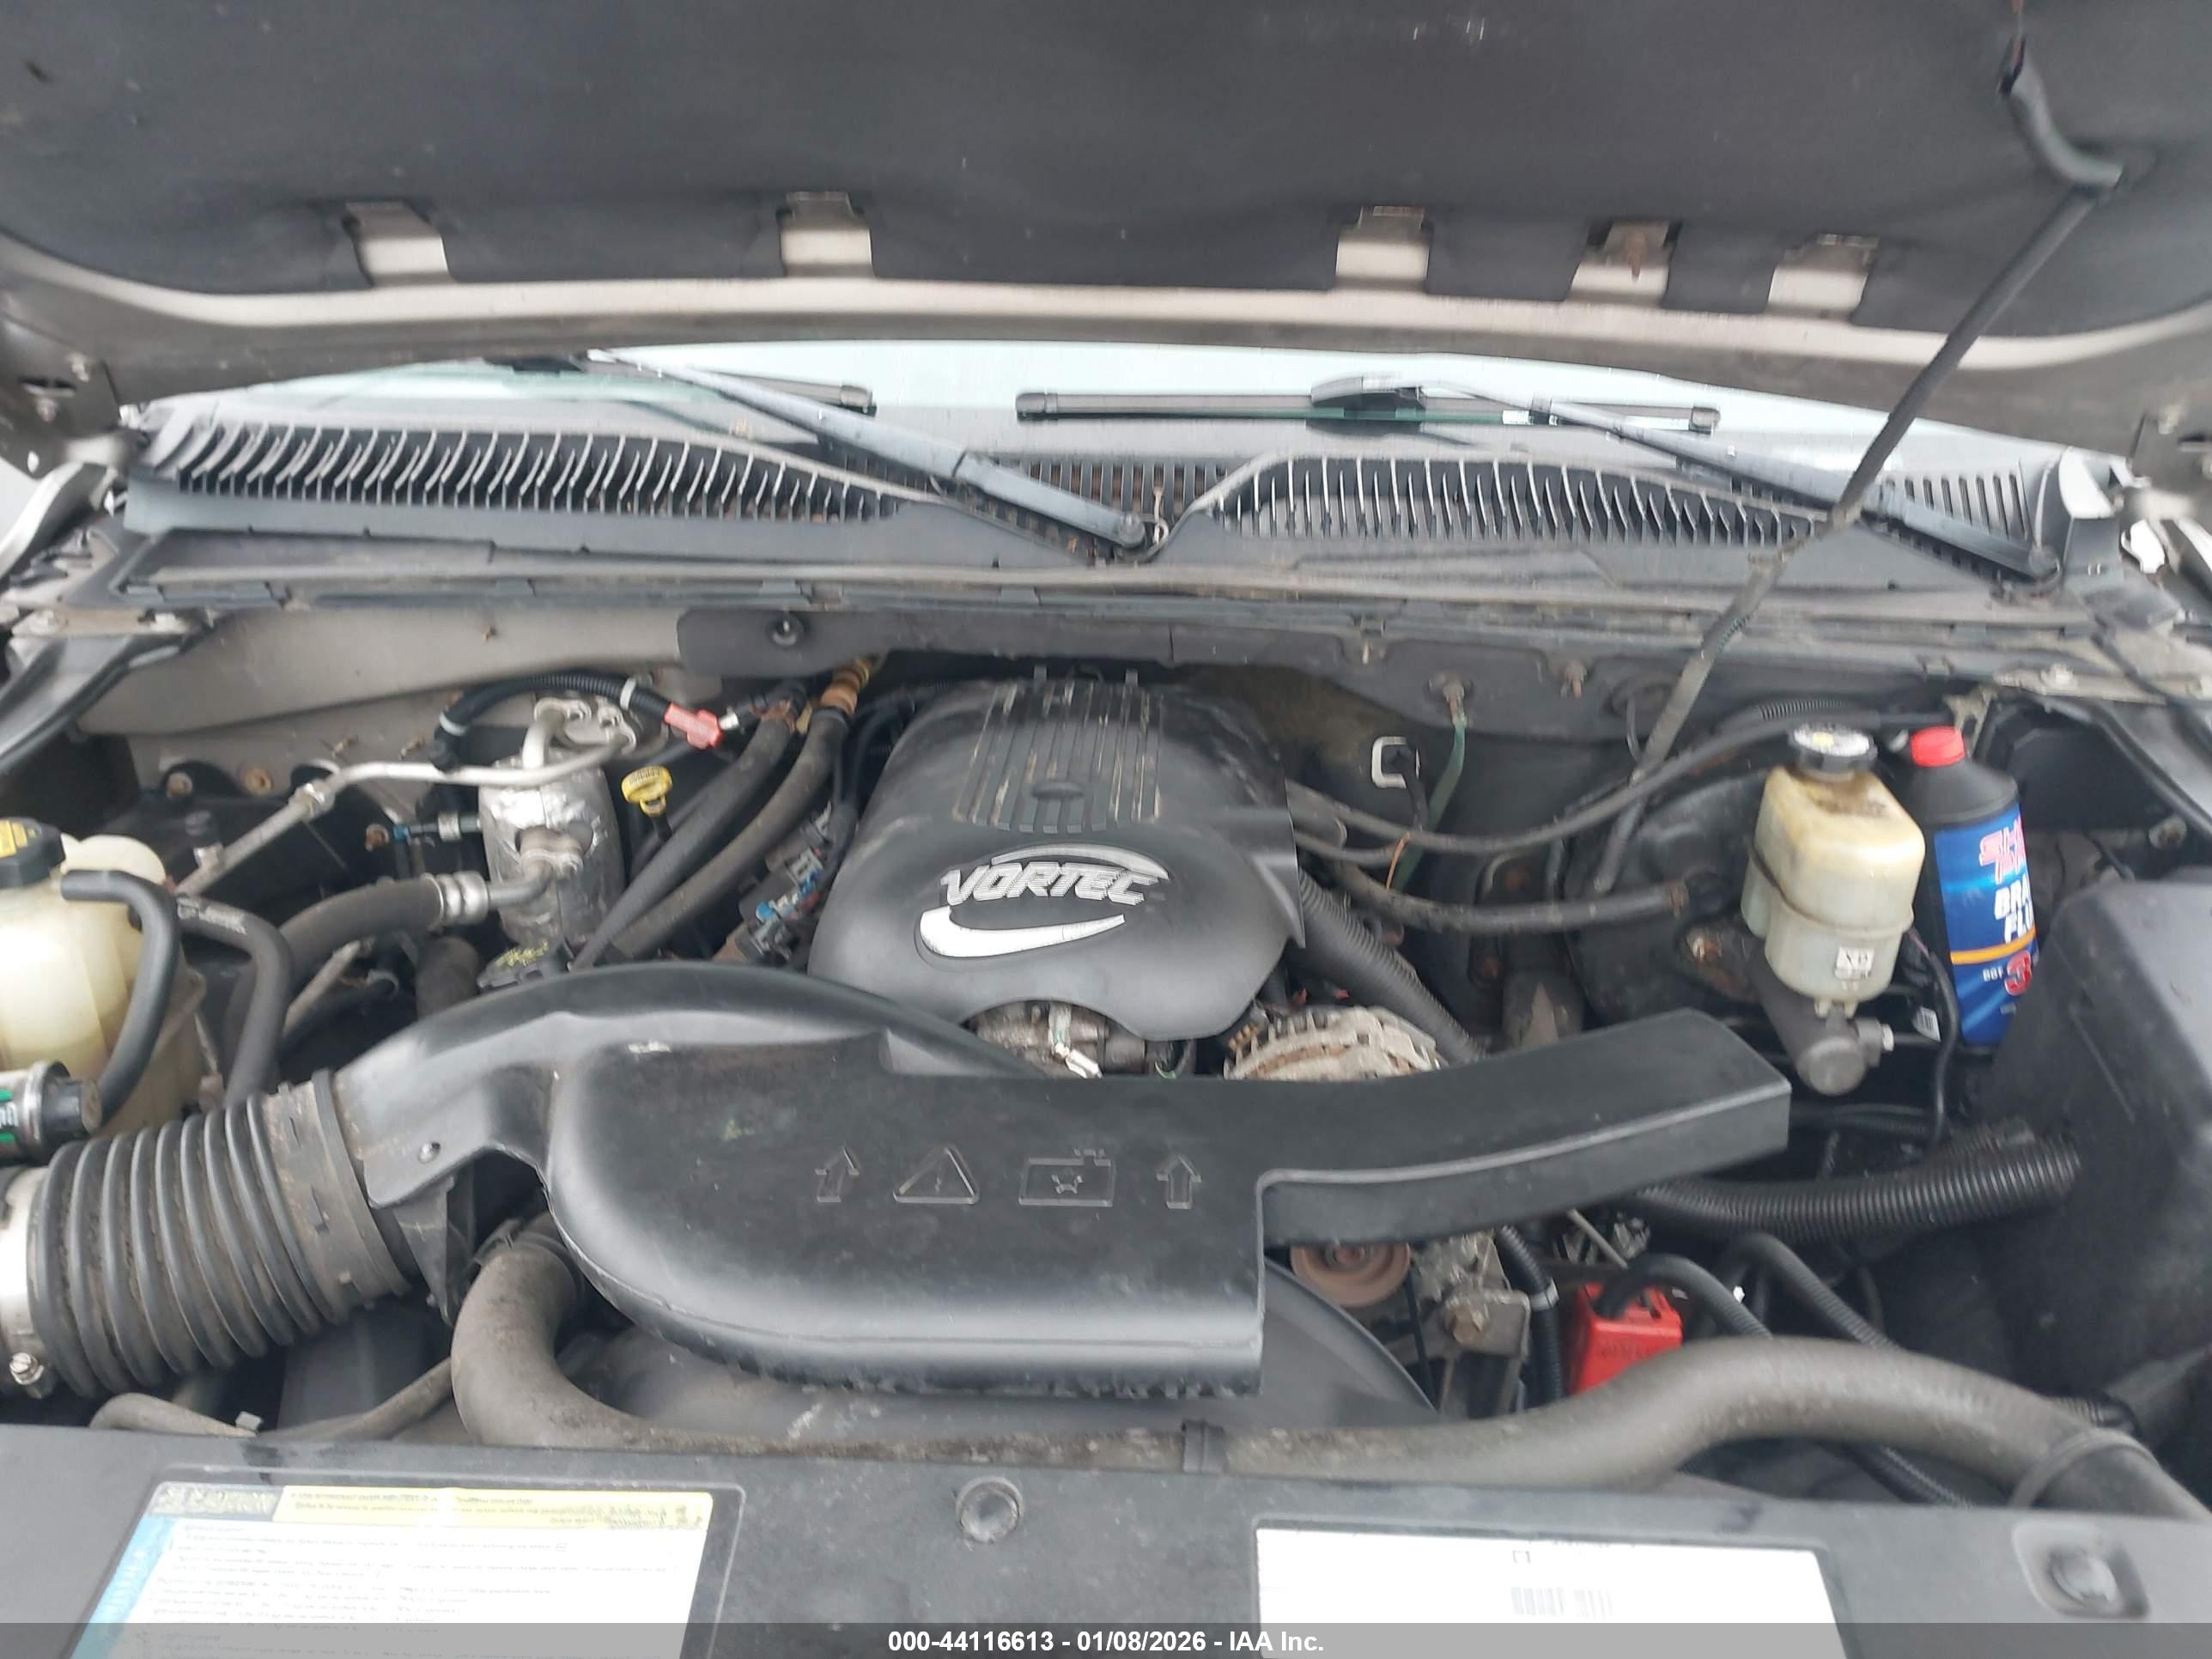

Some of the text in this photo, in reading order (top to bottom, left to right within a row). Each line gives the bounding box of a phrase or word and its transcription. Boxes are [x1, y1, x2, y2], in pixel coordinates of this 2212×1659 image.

[940, 861, 1158, 906] VORTEC
[1994, 872, 2033, 921] BRA
[2004, 900, 2034, 944] FLU
[2004, 950, 2033, 996] 3
